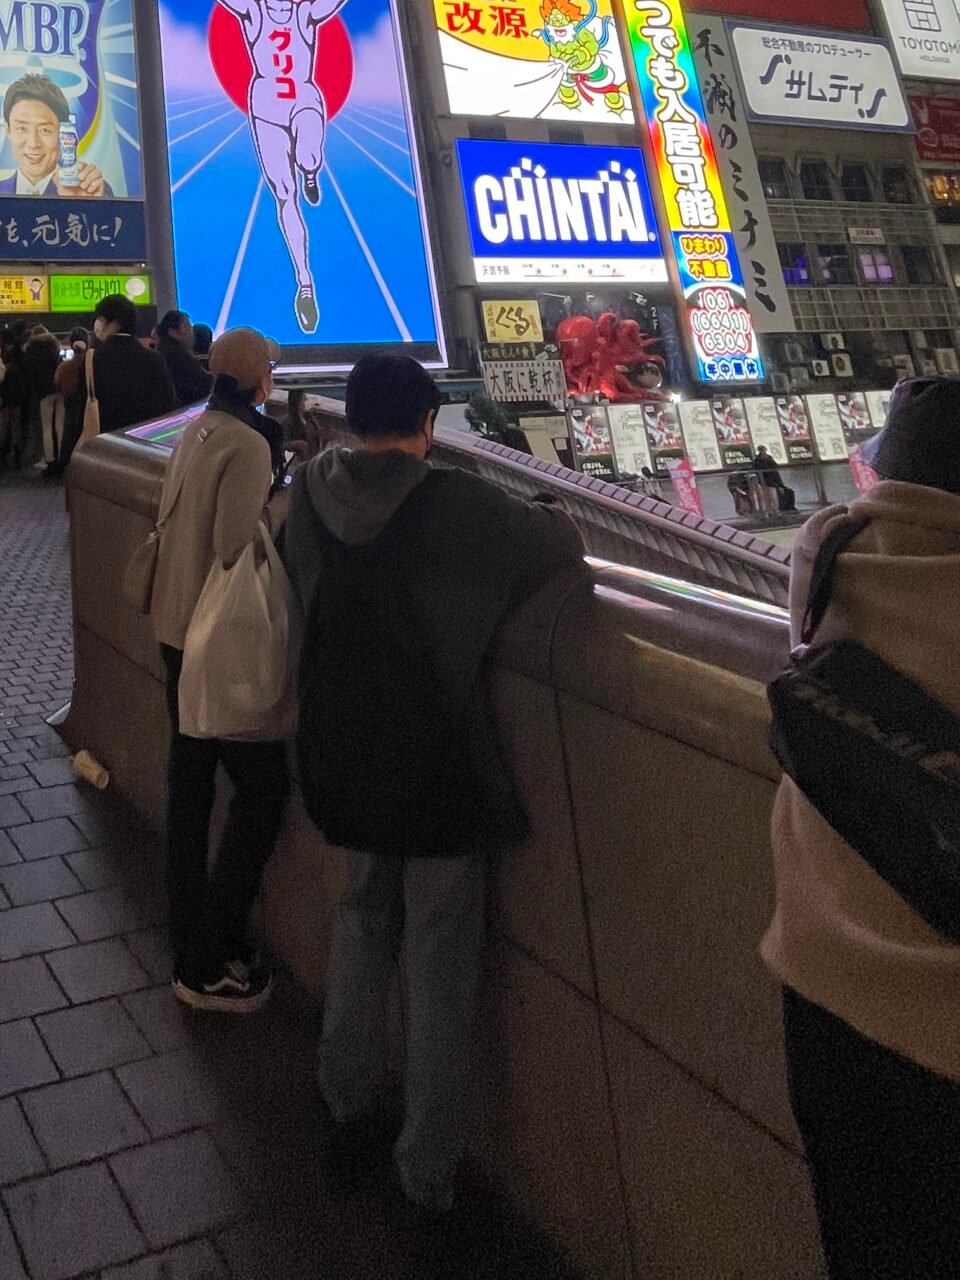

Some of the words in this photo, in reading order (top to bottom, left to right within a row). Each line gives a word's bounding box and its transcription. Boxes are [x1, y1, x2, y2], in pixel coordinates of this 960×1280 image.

[443, 1, 529, 39] 改源
[761, 36, 872, 58] 総合不動産のプロデューサー
[898, 36, 960, 55] TOYOTOM
[268, 27, 297, 100] グリコ
[784, 69, 865, 105] サムティ
[681, 236, 726, 255] ひまわり
[688, 259, 730, 279] 不動産
[703, 291, 729, 310] 06
[495, 306, 530, 336] くくる
[703, 332, 747, 351] 6304
[490, 368, 554, 395] 大阪に乾杯
